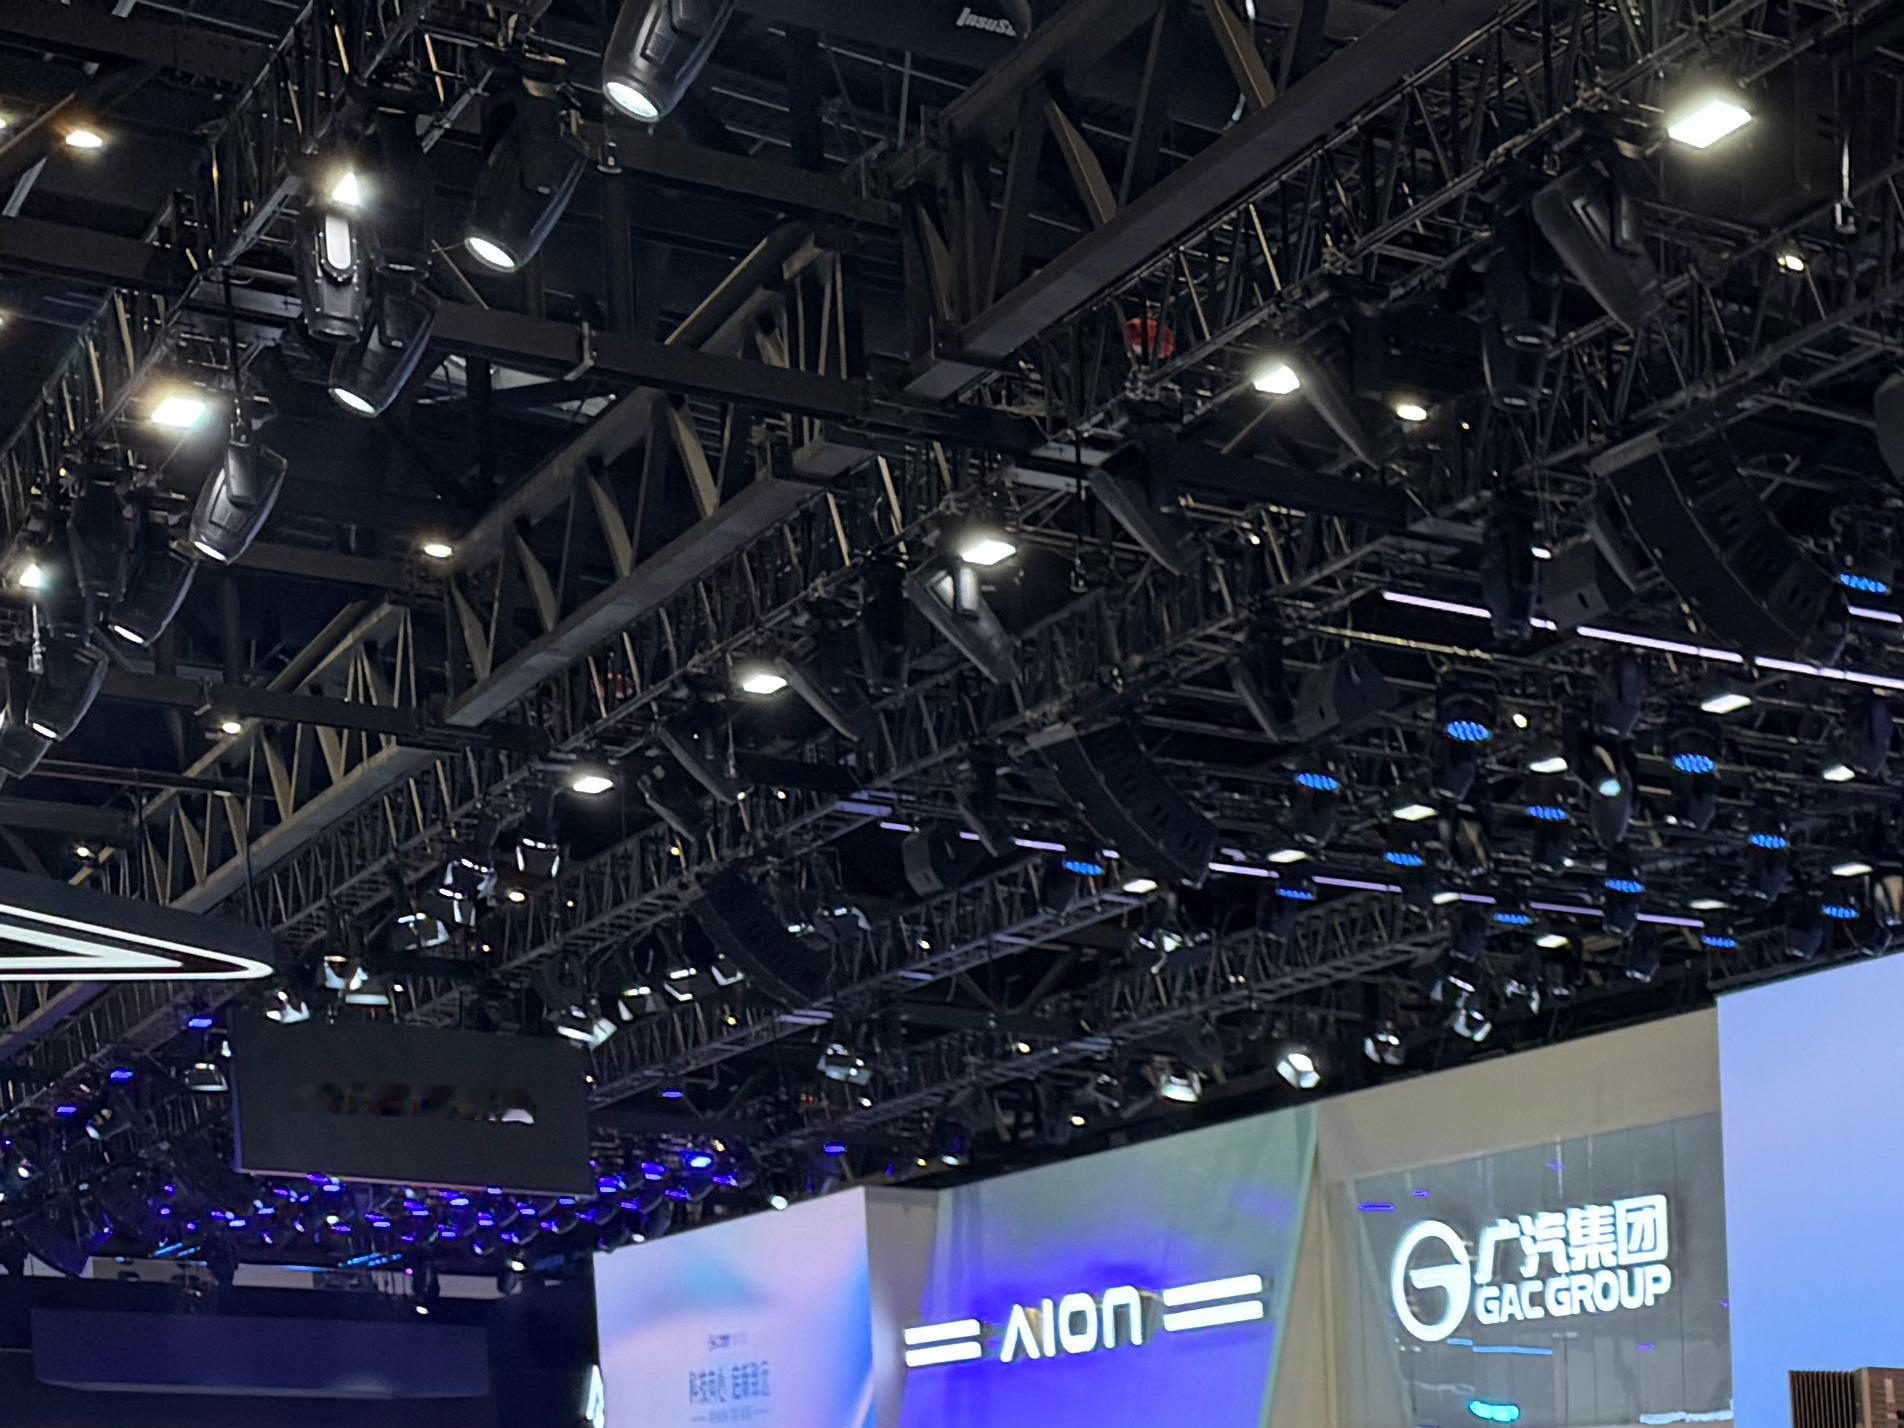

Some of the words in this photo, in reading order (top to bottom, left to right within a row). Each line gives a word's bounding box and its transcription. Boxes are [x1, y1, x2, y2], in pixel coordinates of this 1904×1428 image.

[1474, 1193, 1670, 1286] 广汽集团
[1474, 1280, 1545, 1325] GAC
[1544, 1264, 1672, 1317] GROUP
